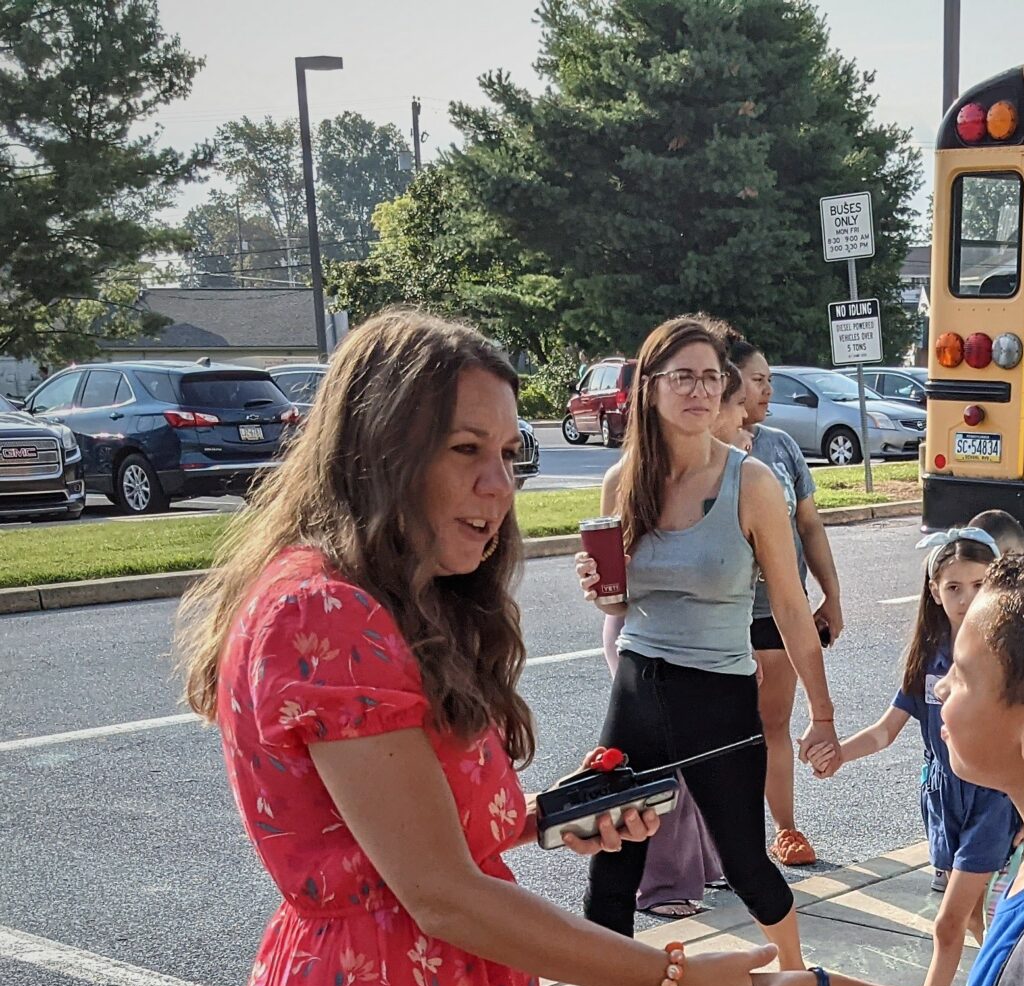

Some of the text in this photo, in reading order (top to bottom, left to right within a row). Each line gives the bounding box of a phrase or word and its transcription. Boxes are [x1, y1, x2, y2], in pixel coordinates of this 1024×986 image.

[830, 202, 862, 216] BUSES
[834, 215, 859, 228] ONLY
[835, 226, 860, 236] MON FRI
[860, 233, 870, 241] AM
[859, 241, 869, 249] PM
[835, 302, 872, 318] NO IDLING
[852, 321, 875, 331] POWERED
[838, 331, 874, 342] VEHICLES OVER
[847, 342, 867, 353] 5 TONS
[2, 447, 38, 459] GMC
